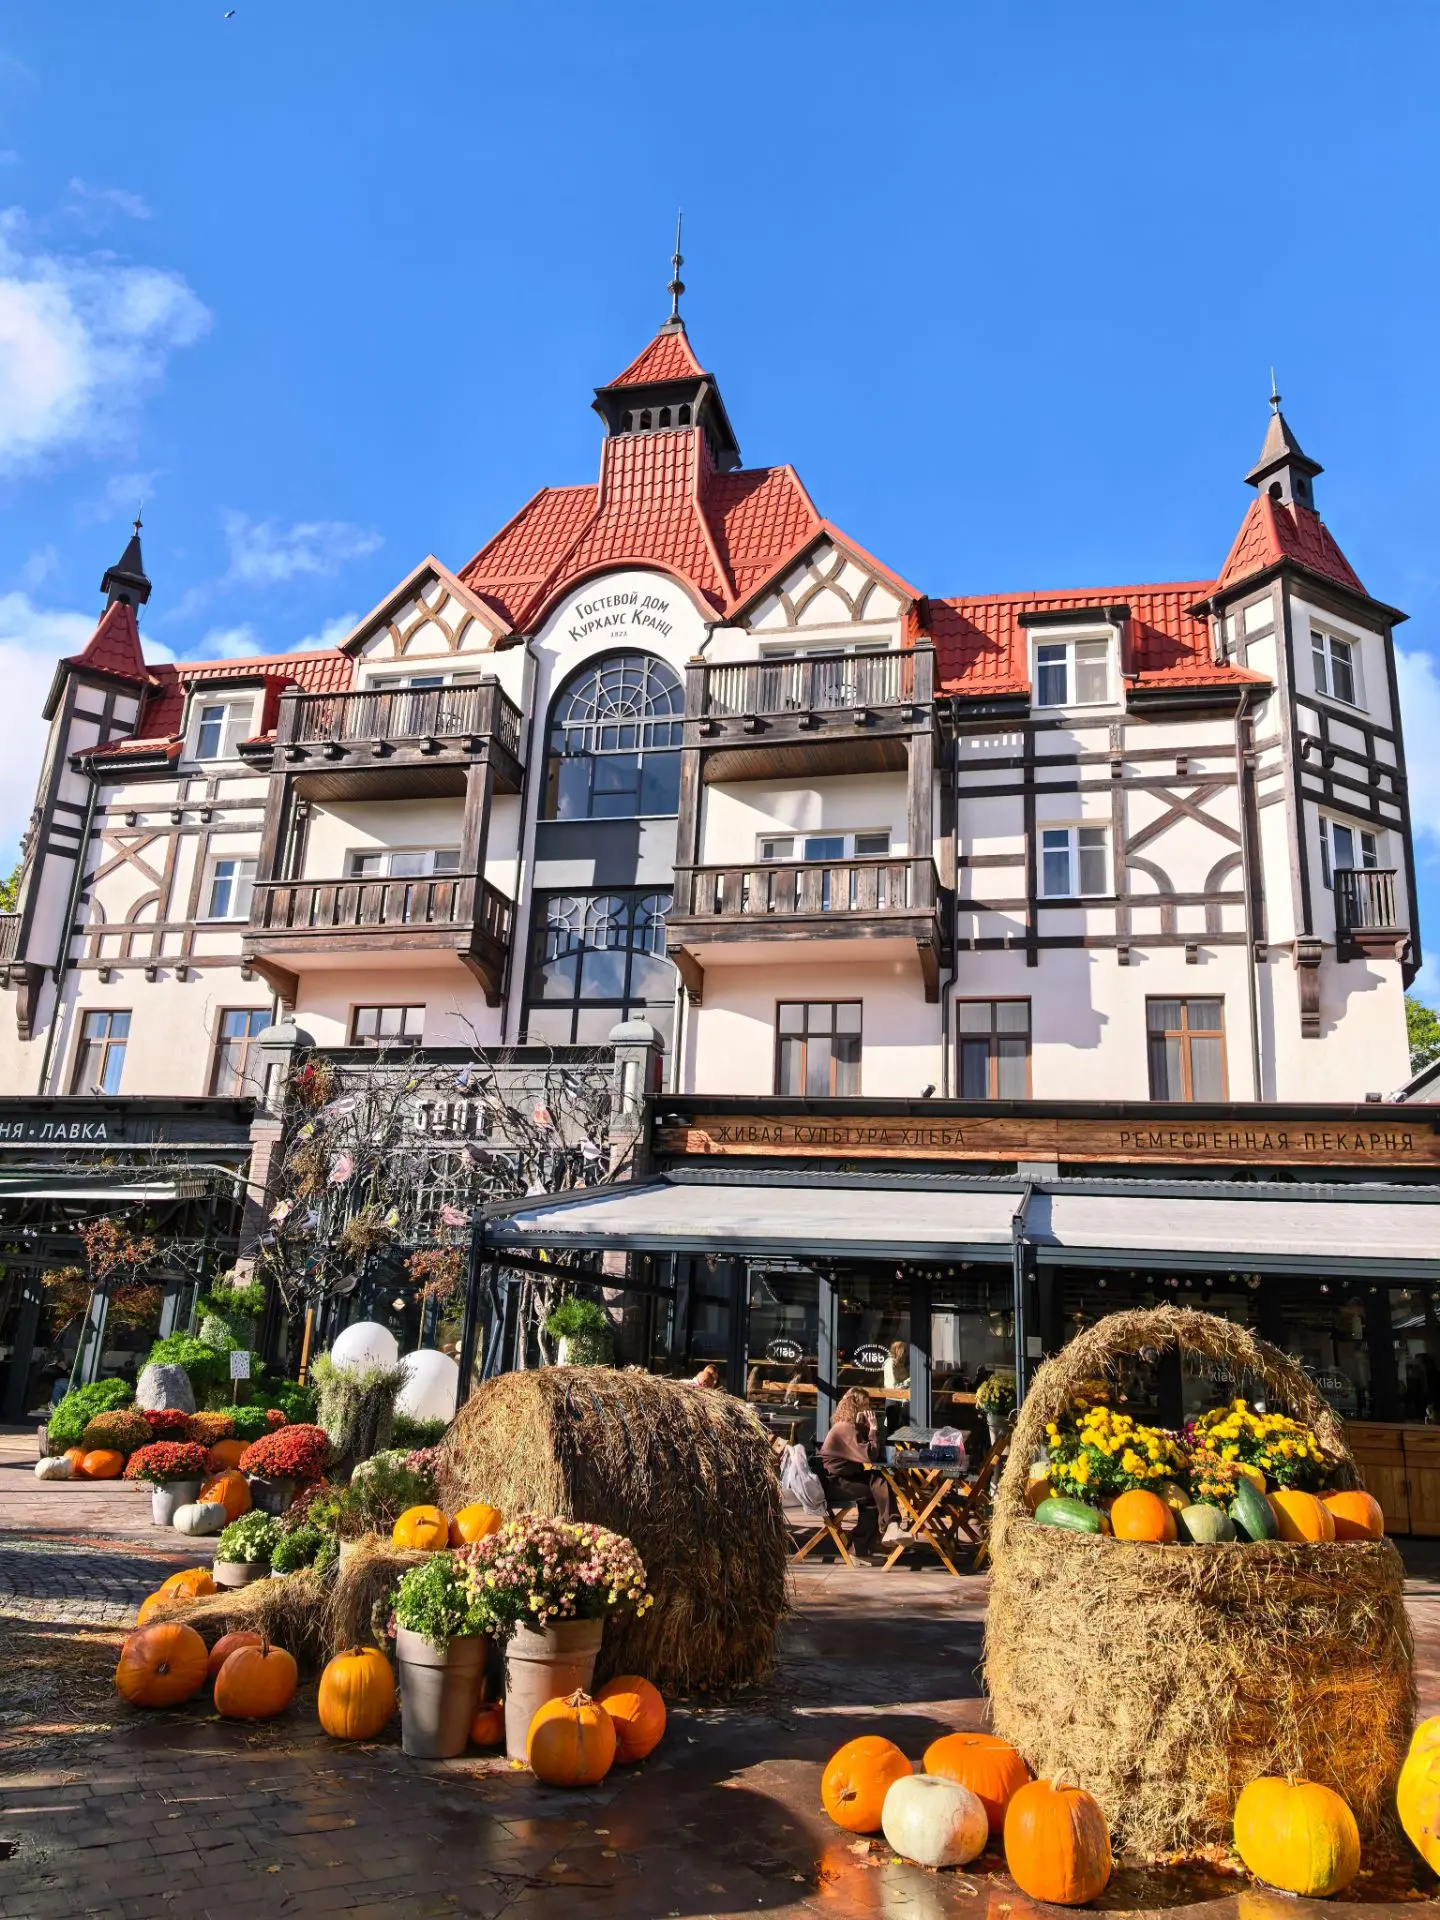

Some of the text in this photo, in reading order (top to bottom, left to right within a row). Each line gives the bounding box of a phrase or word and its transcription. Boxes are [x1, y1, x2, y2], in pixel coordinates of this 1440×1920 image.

[40, 1122, 107, 1139] ЛАВКА
[719, 1126, 965, 1145] ЖИВАЯ КУЛЬТУРА ХЛЕБА
[1120, 1131, 1414, 1151] РЕМЕСЛЕННАЯ ПЕКАРНЯ
